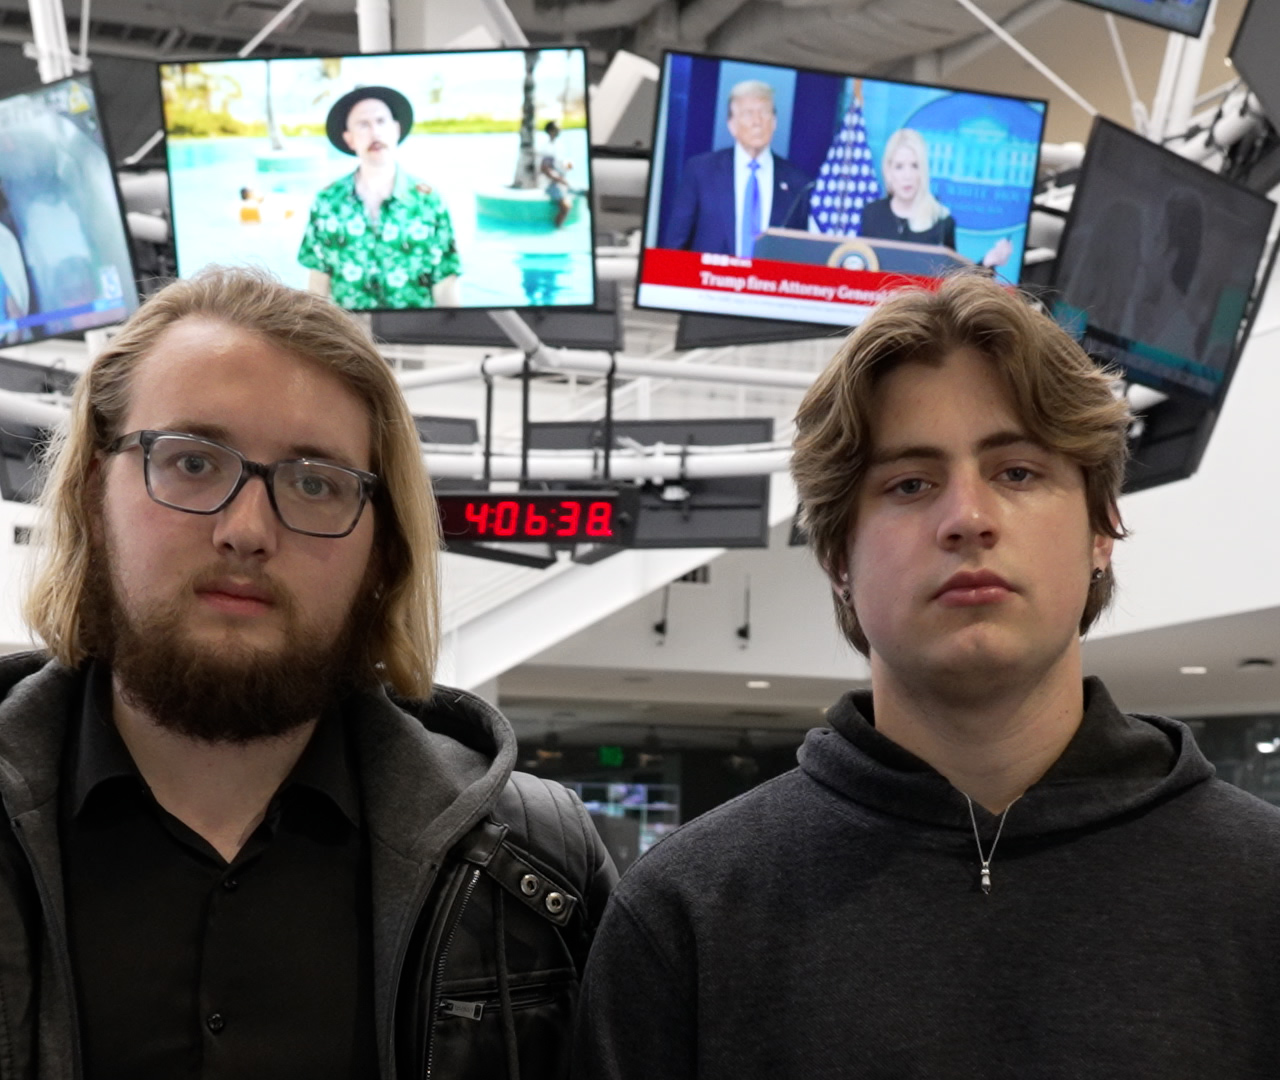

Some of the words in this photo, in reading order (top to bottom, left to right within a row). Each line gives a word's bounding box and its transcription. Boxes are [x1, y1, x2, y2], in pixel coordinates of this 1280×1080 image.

[700, 270, 746, 292] Trump
[746, 274, 777, 292] fires
[778, 279, 835, 301] Attorney
